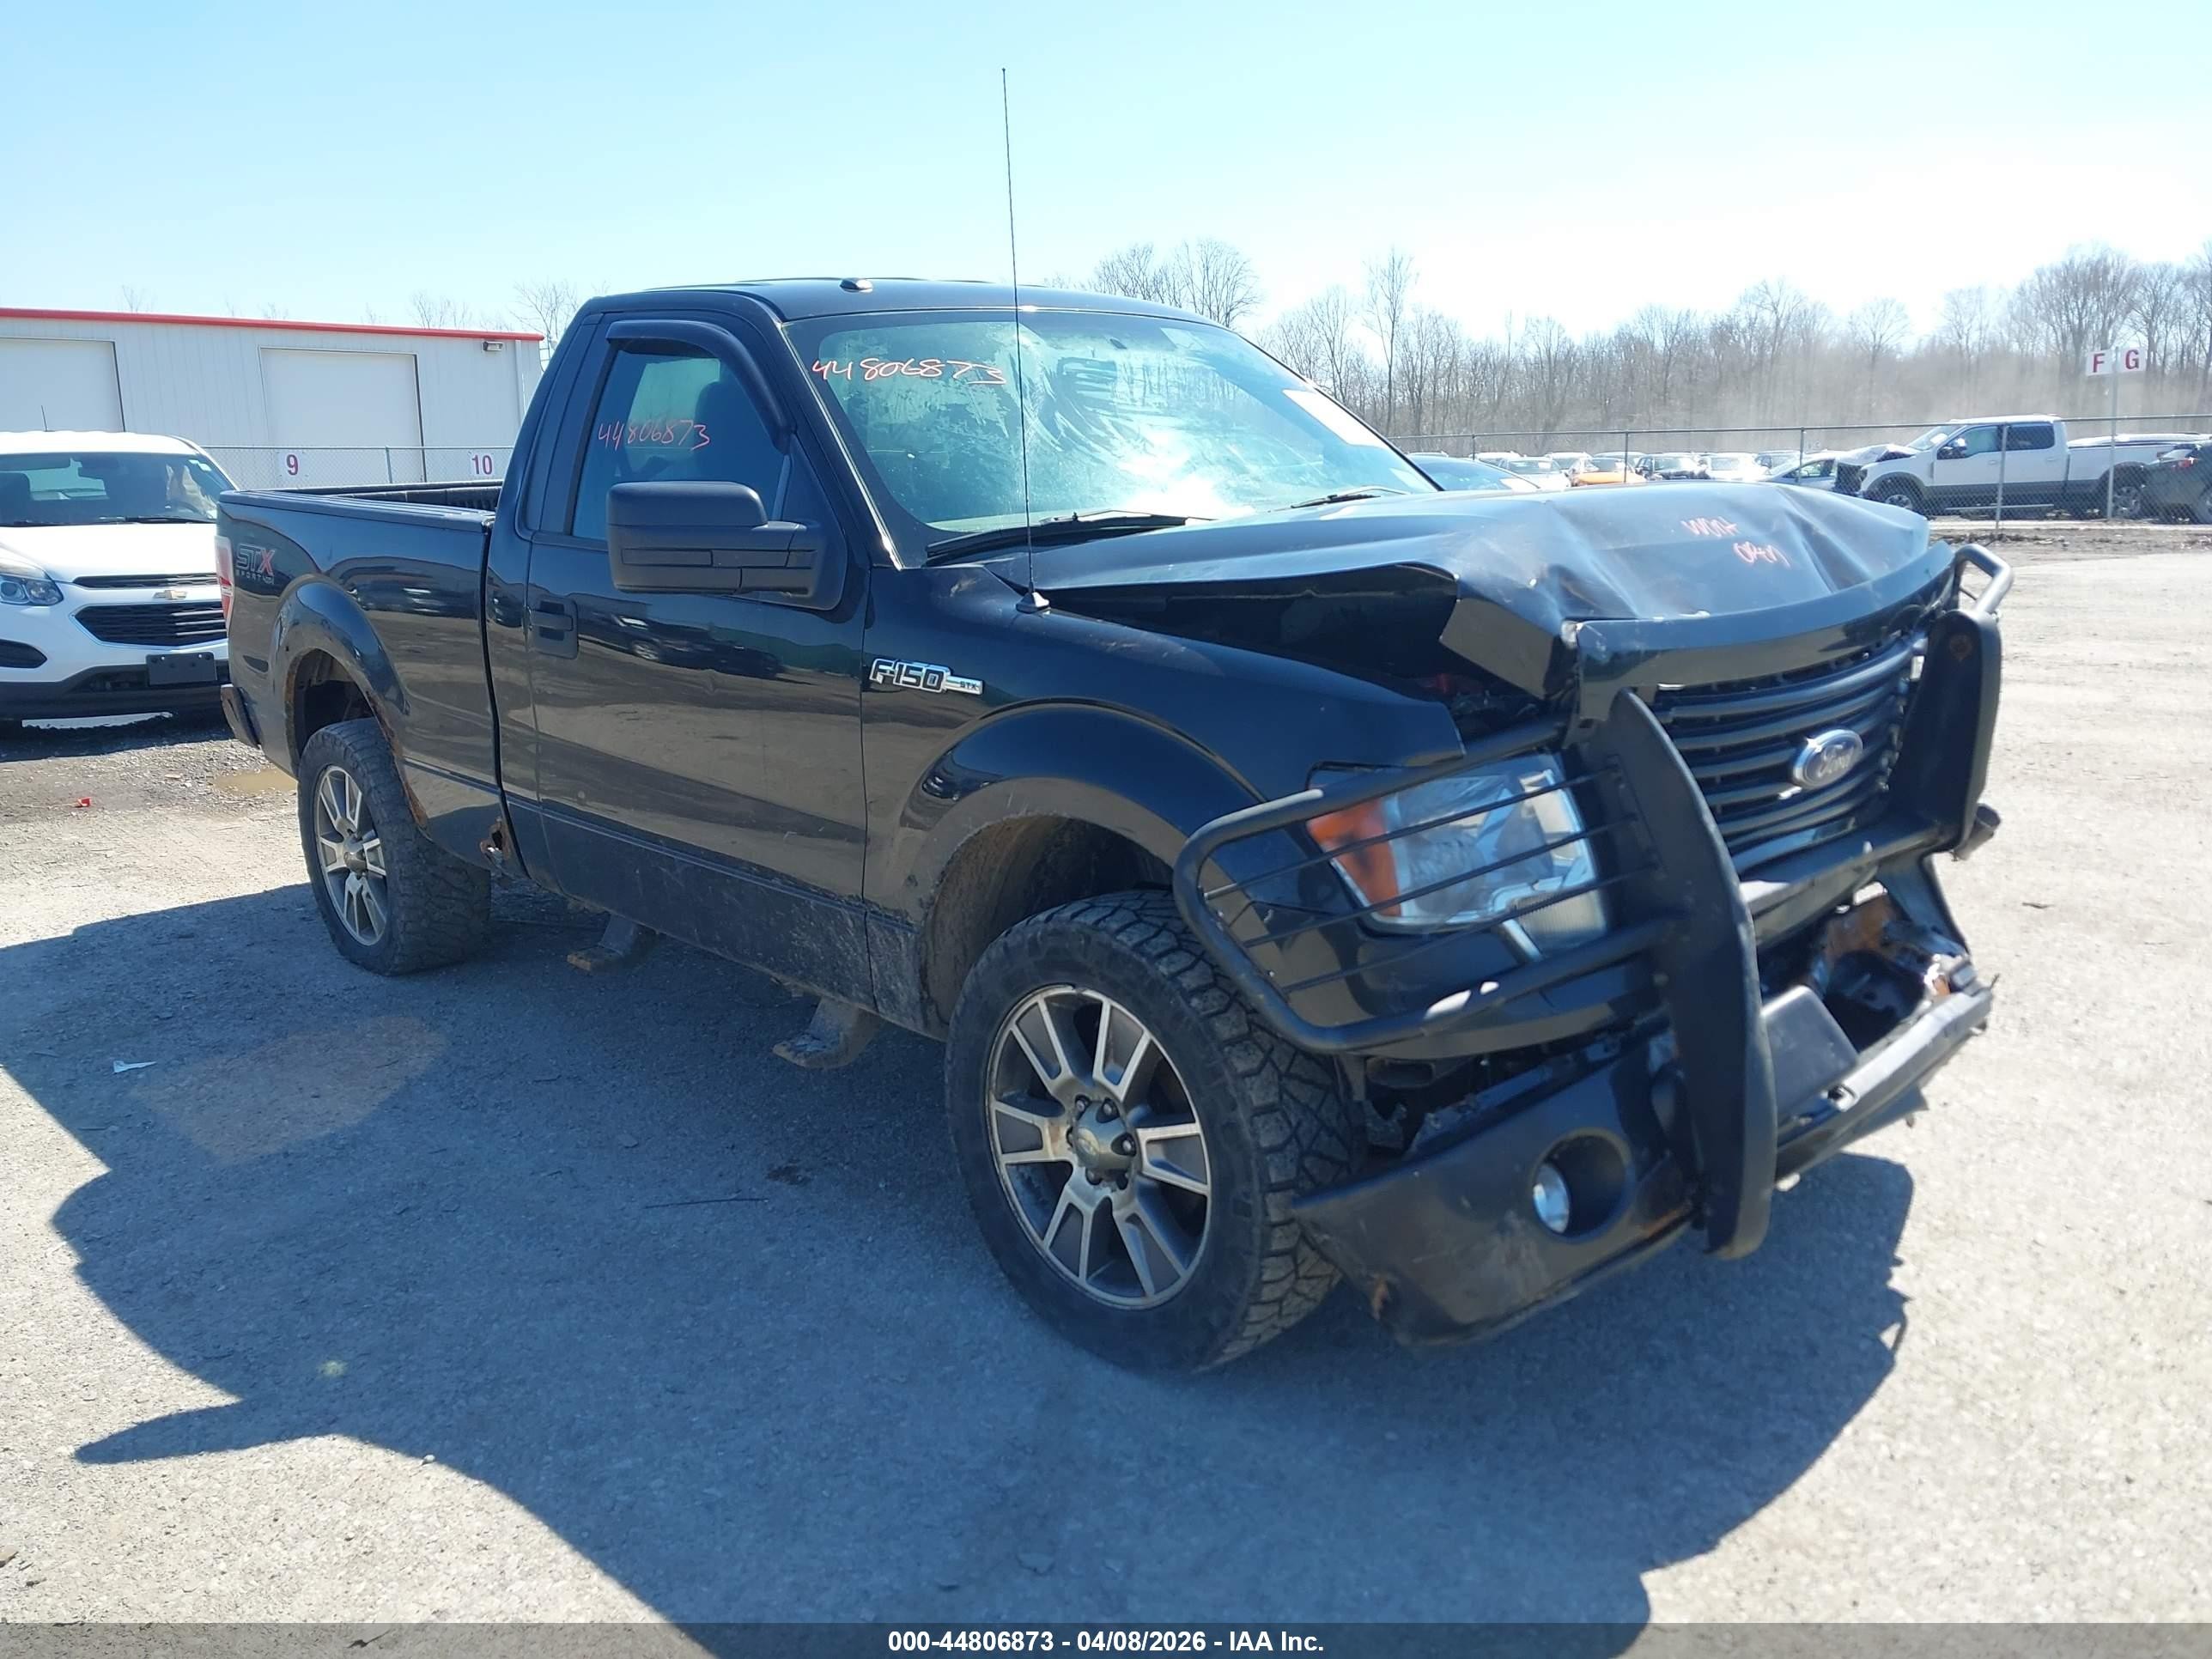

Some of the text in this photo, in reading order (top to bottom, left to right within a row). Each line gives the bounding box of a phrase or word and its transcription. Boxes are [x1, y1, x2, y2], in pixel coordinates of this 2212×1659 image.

[2093, 353, 2106, 373] F
[2125, 349, 2139, 370] G
[598, 419, 710, 452] 44806873
[286, 454, 299, 476] 9
[471, 455, 493, 475] 10
[236, 543, 275, 576] STX
